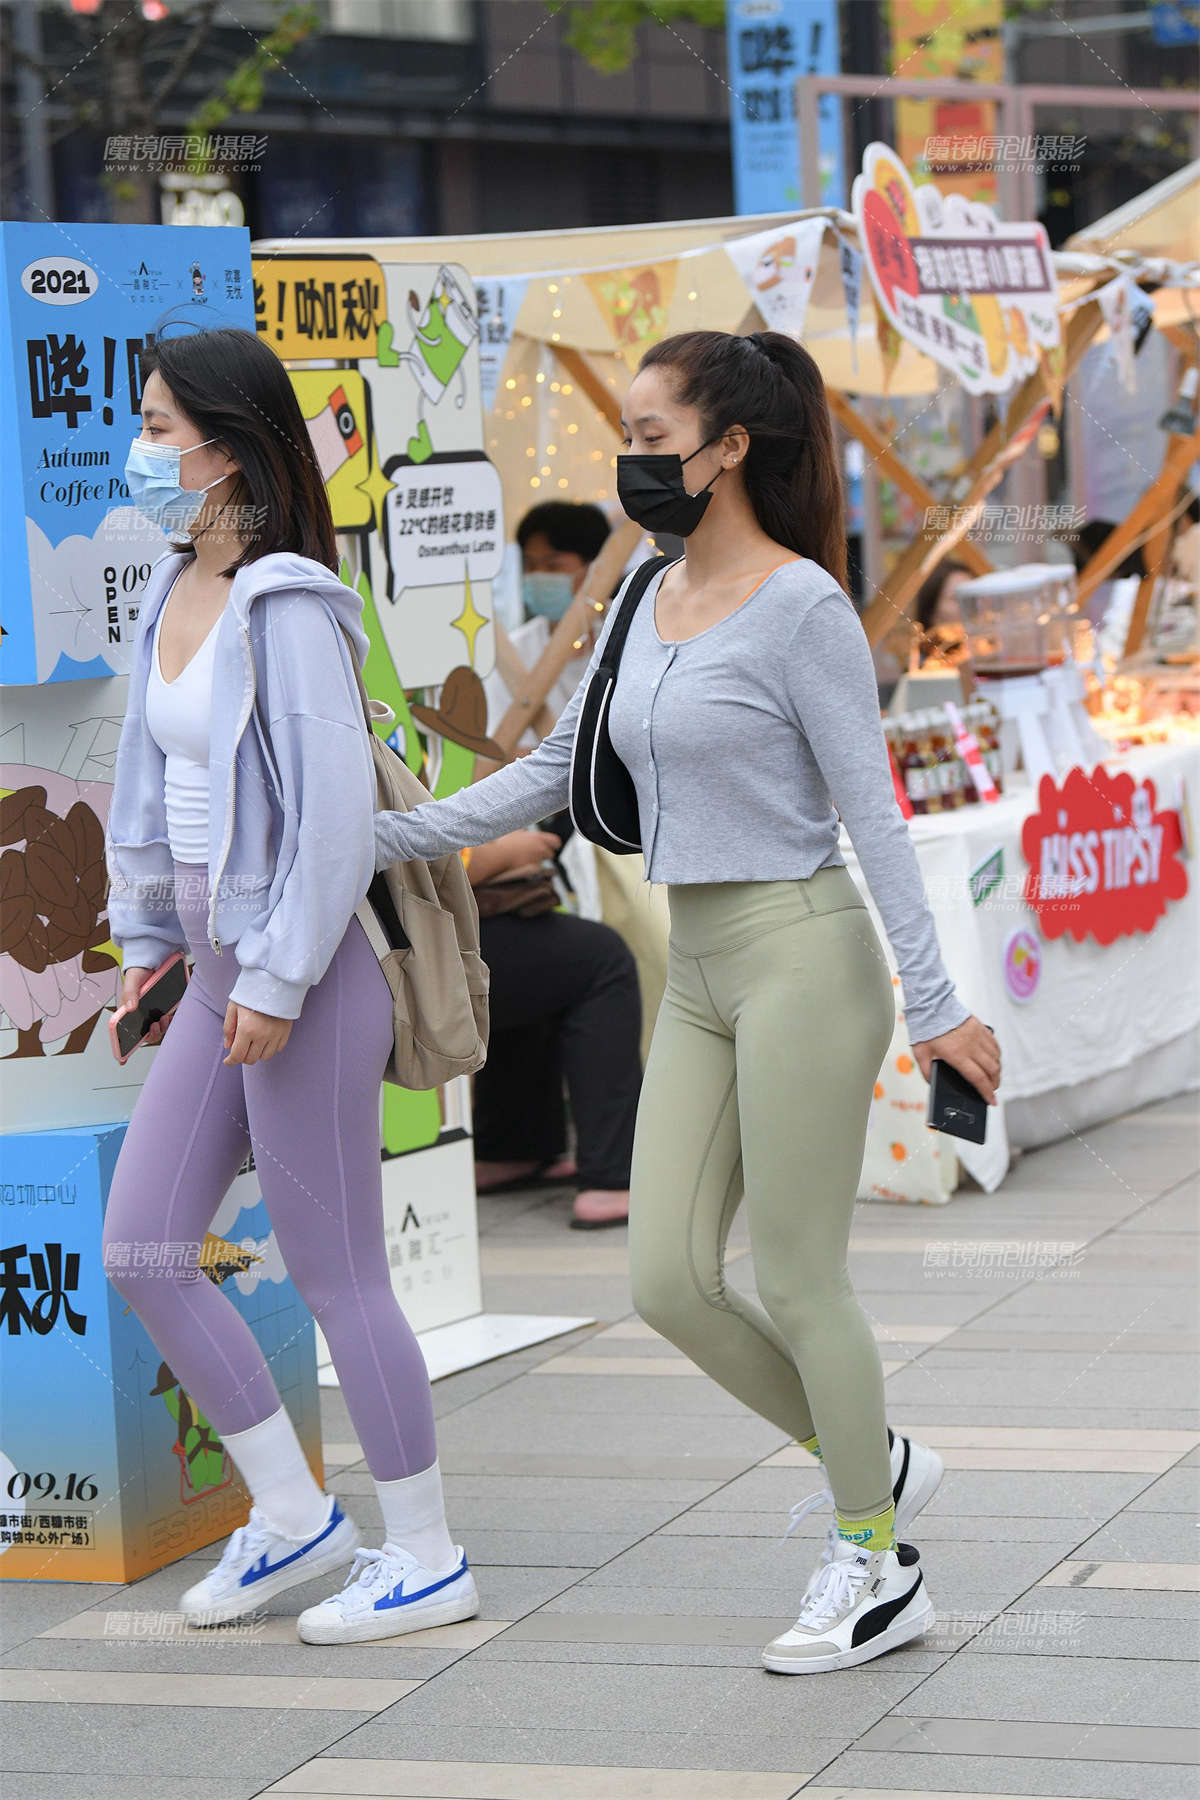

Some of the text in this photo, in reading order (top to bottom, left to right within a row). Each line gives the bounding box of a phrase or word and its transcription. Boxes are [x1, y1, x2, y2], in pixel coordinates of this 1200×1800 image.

[31, 269, 90, 294] 2021
[38, 447, 110, 470] Autumn
[40, 479, 104, 507] Coffee
[406, 486, 453, 509] 灵感开饮
[418, 540, 496, 558] Osmanthus Latte
[104, 566, 121, 644] OPEN
[1101, 804, 1163, 891] TIPSY
[7, 1471, 99, 1501] 09.16
